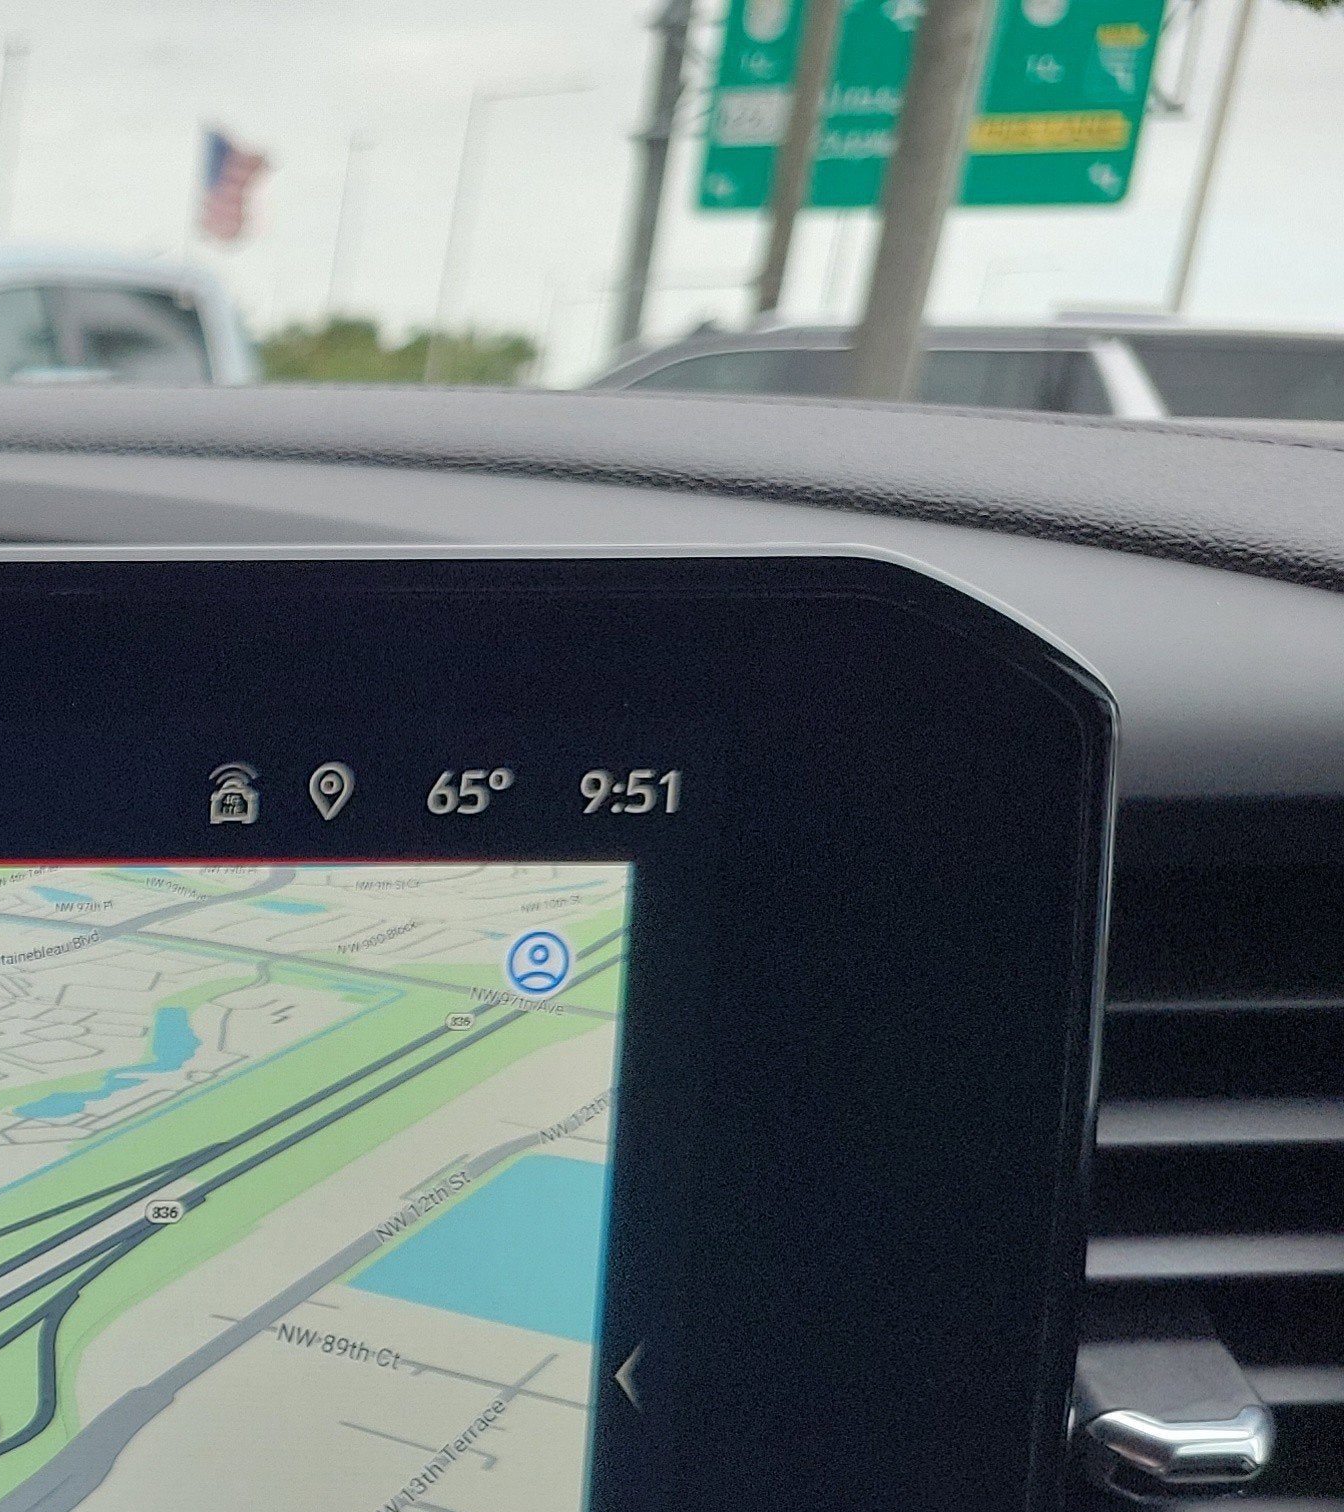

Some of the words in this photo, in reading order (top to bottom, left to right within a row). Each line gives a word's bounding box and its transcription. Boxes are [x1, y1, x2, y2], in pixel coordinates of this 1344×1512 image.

[579, 768, 683, 815] 9:51
[469, 985, 499, 1004] NW
[538, 1122, 570, 1144] NW
[572, 1096, 608, 1128] 12th
[151, 1205, 179, 1220] 836
[374, 1213, 408, 1243] NW
[407, 1184, 450, 1220] 12th
[448, 1170, 472, 1191] St
[276, 1322, 315, 1349] NW
[322, 1333, 370, 1362] 89th
[375, 1347, 402, 1371] Ct
[400, 1461, 446, 1505] 13th
[439, 1398, 507, 1464] Terrace
